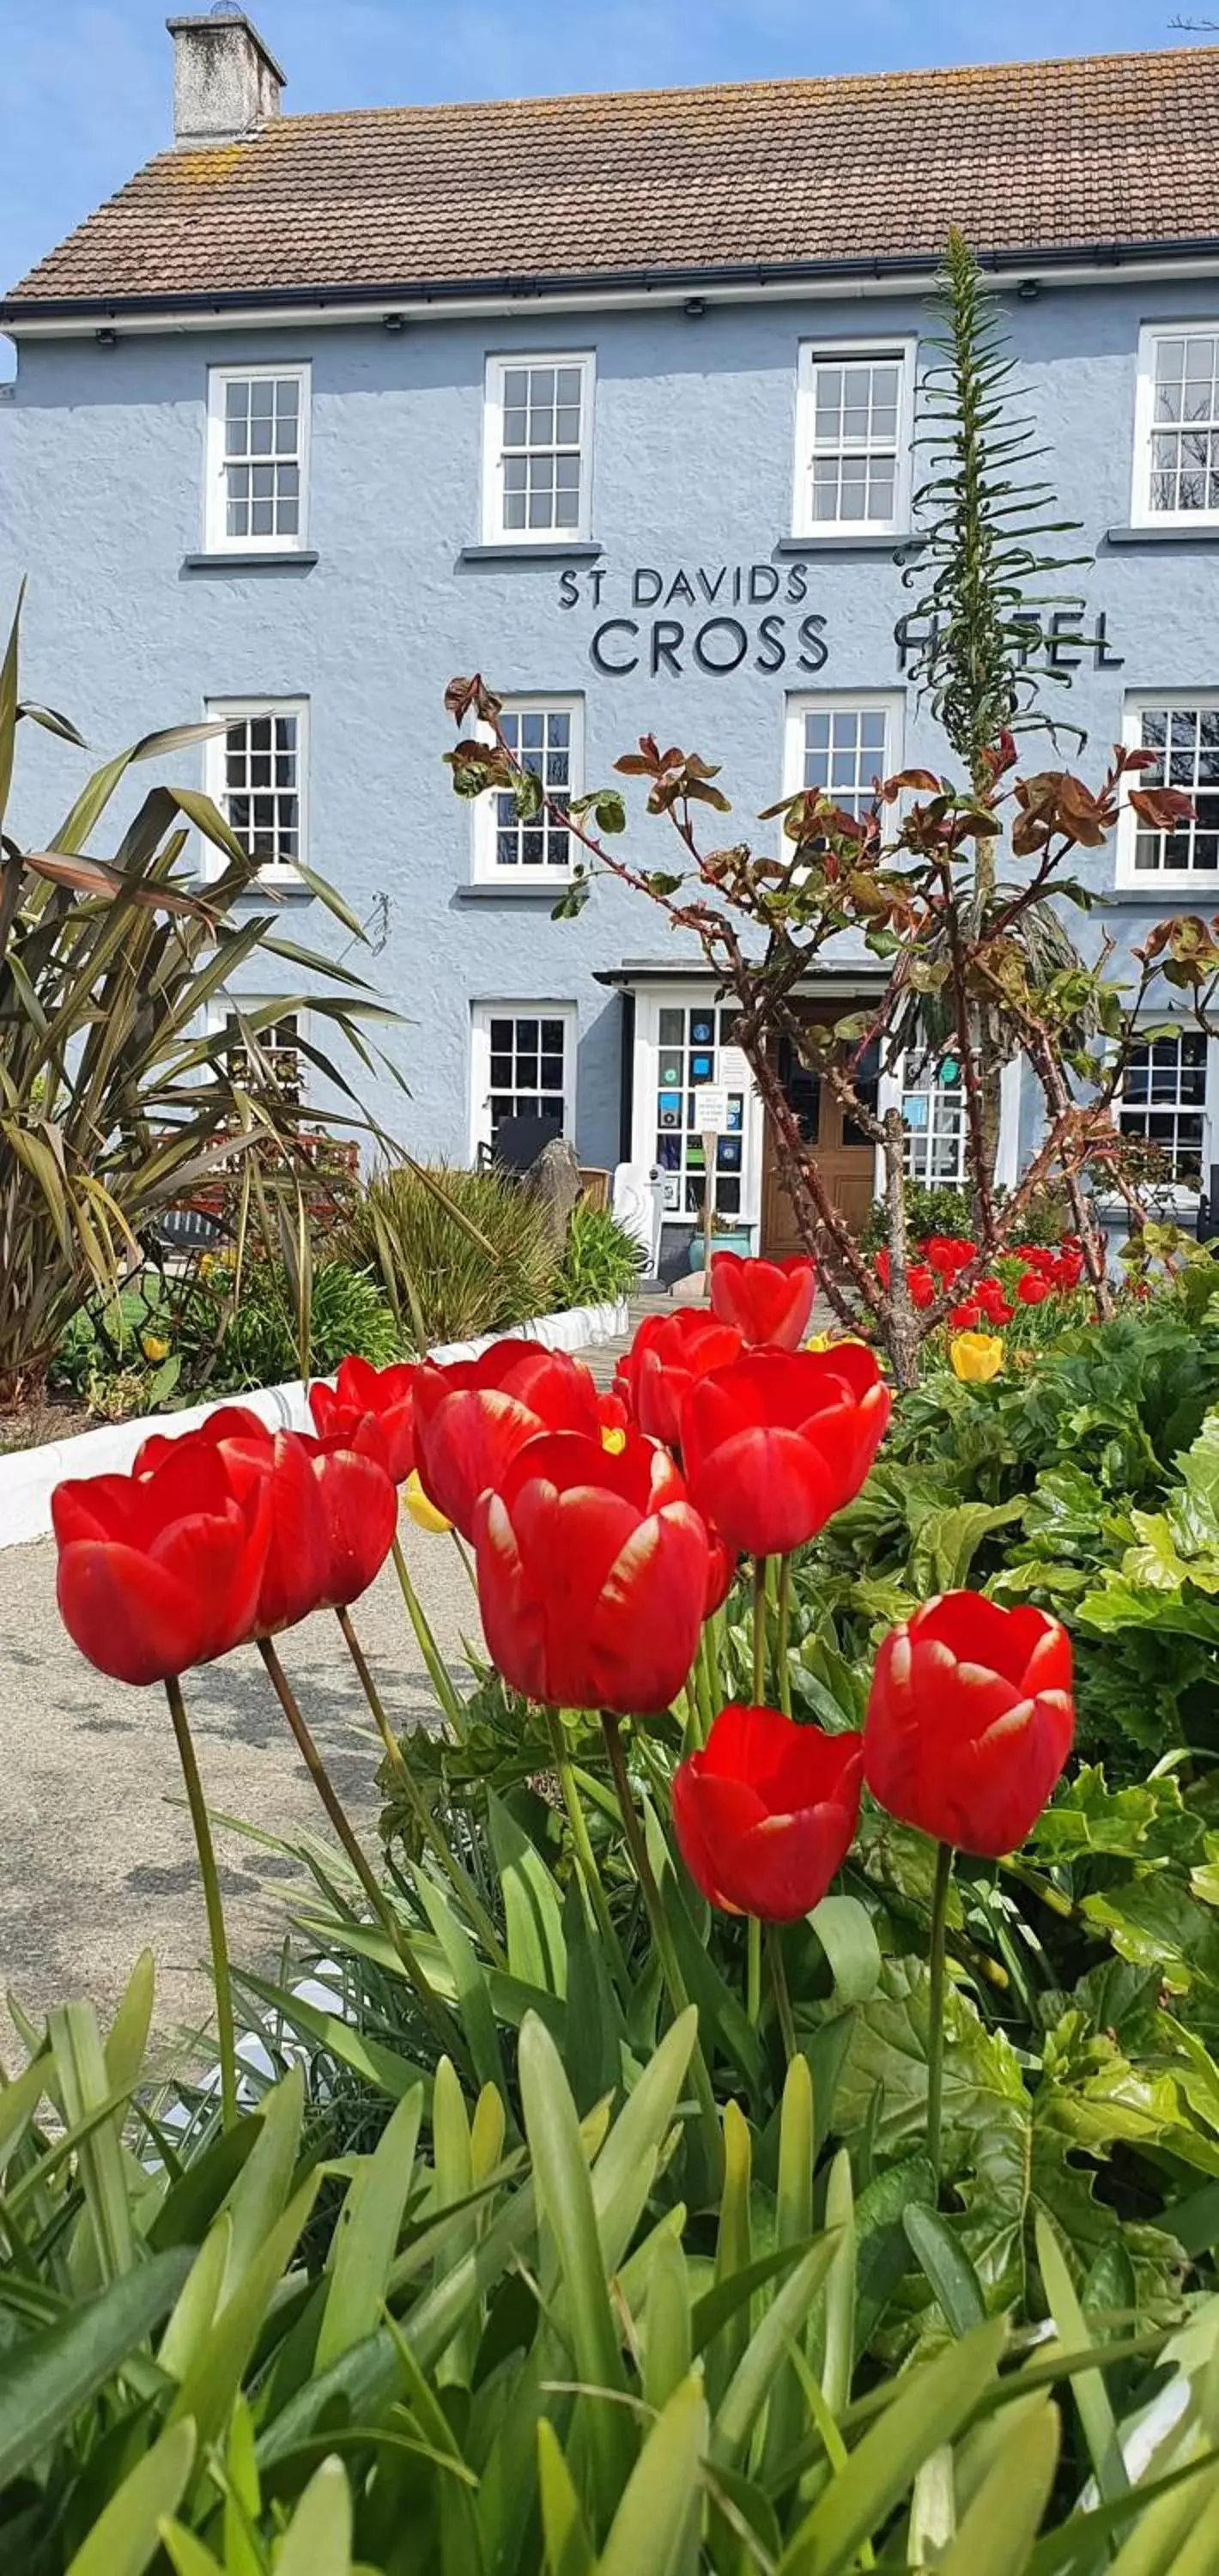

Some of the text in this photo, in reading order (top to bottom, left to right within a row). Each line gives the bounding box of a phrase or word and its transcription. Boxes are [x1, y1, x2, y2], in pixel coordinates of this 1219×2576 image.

[559, 563, 809, 608] ST DAVIDS
[591, 611, 1125, 677] CROSS HTEL
